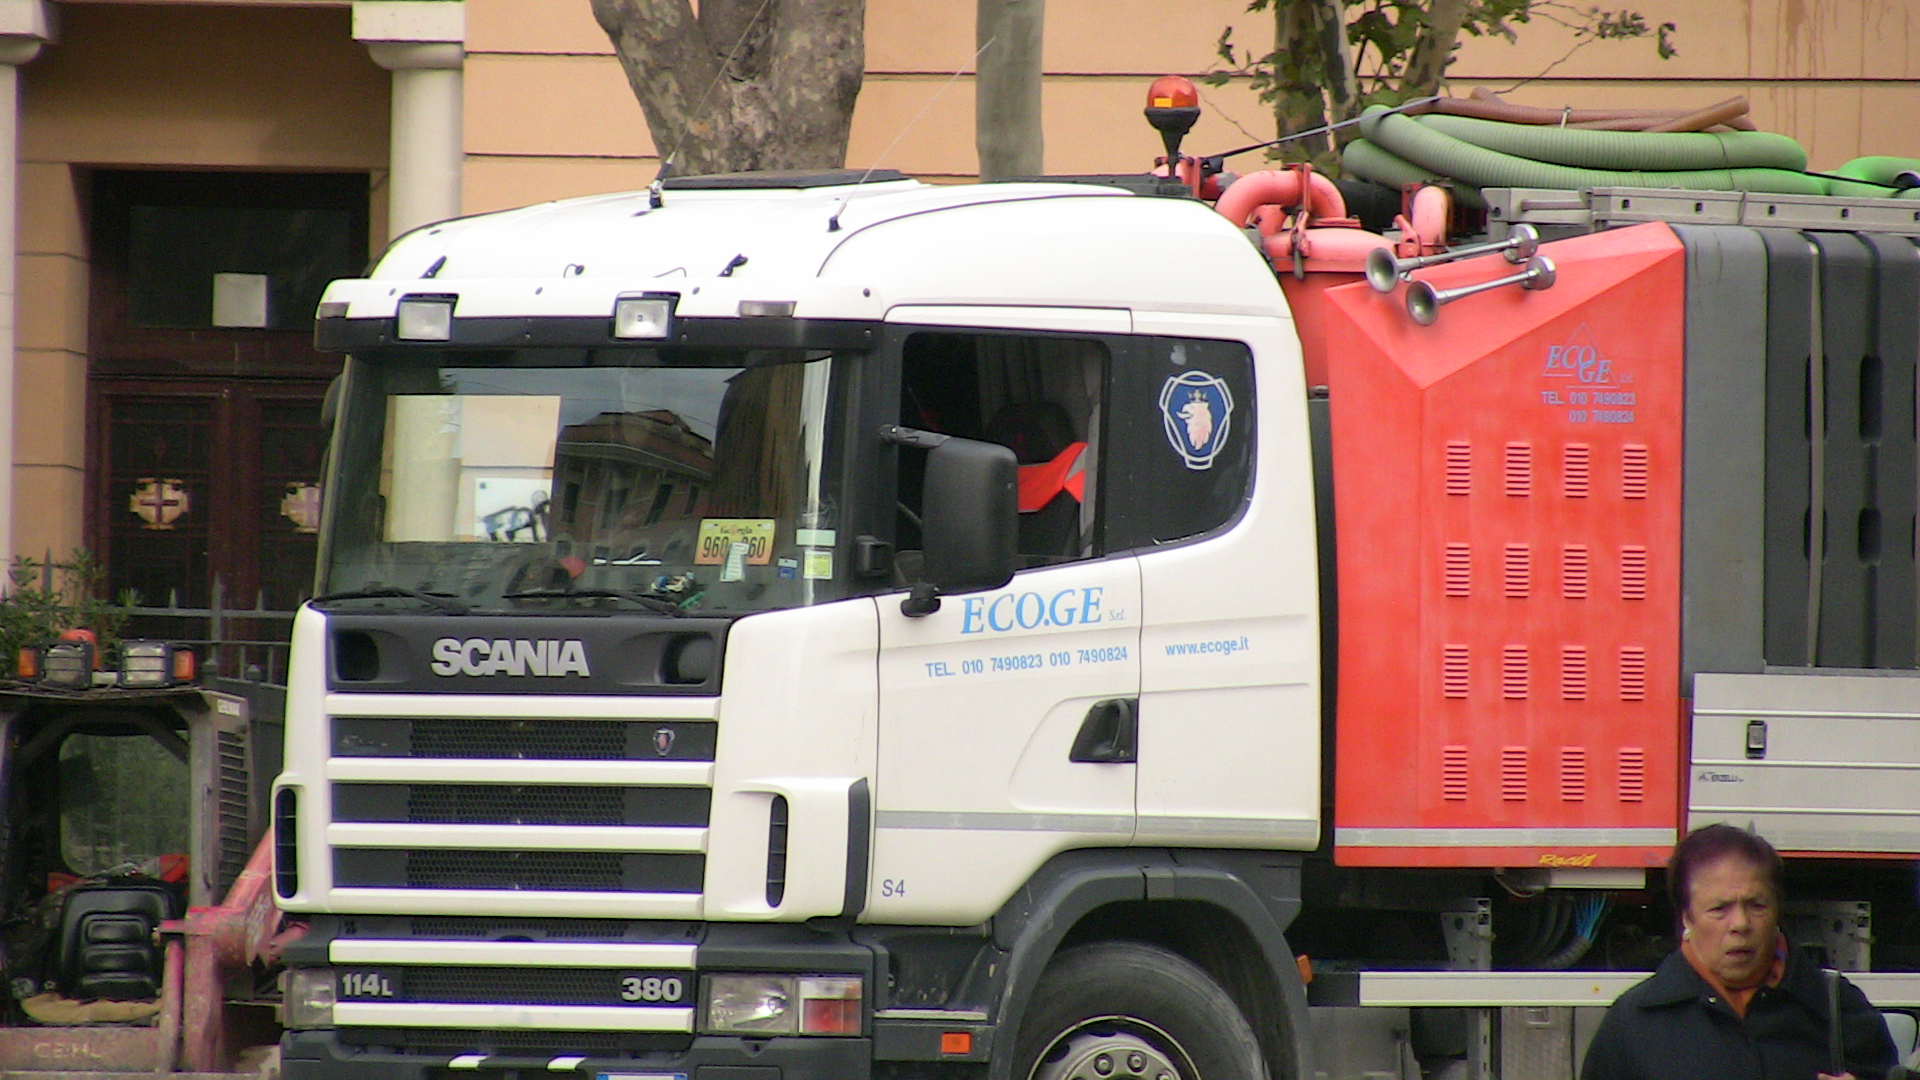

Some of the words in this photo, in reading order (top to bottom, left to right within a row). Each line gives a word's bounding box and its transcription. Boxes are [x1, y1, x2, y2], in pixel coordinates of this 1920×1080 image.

[1570, 392, 1587, 404] 010
[1592, 392, 1636, 405] 7490823
[1570, 410, 1587, 423] 010
[960, 587, 1104, 634] ECO.GE
[431, 637, 591, 677] SCANIA
[1165, 636, 1250, 657] www.ecoge.it
[925, 662, 956, 678] TEL.
[962, 660, 984, 675] 010
[990, 653, 1043, 672] 7490823
[1049, 653, 1071, 666] 010
[1077, 646, 1128, 664] 7490824
[882, 879, 905, 897] S4
[621, 977, 683, 1001] 380
